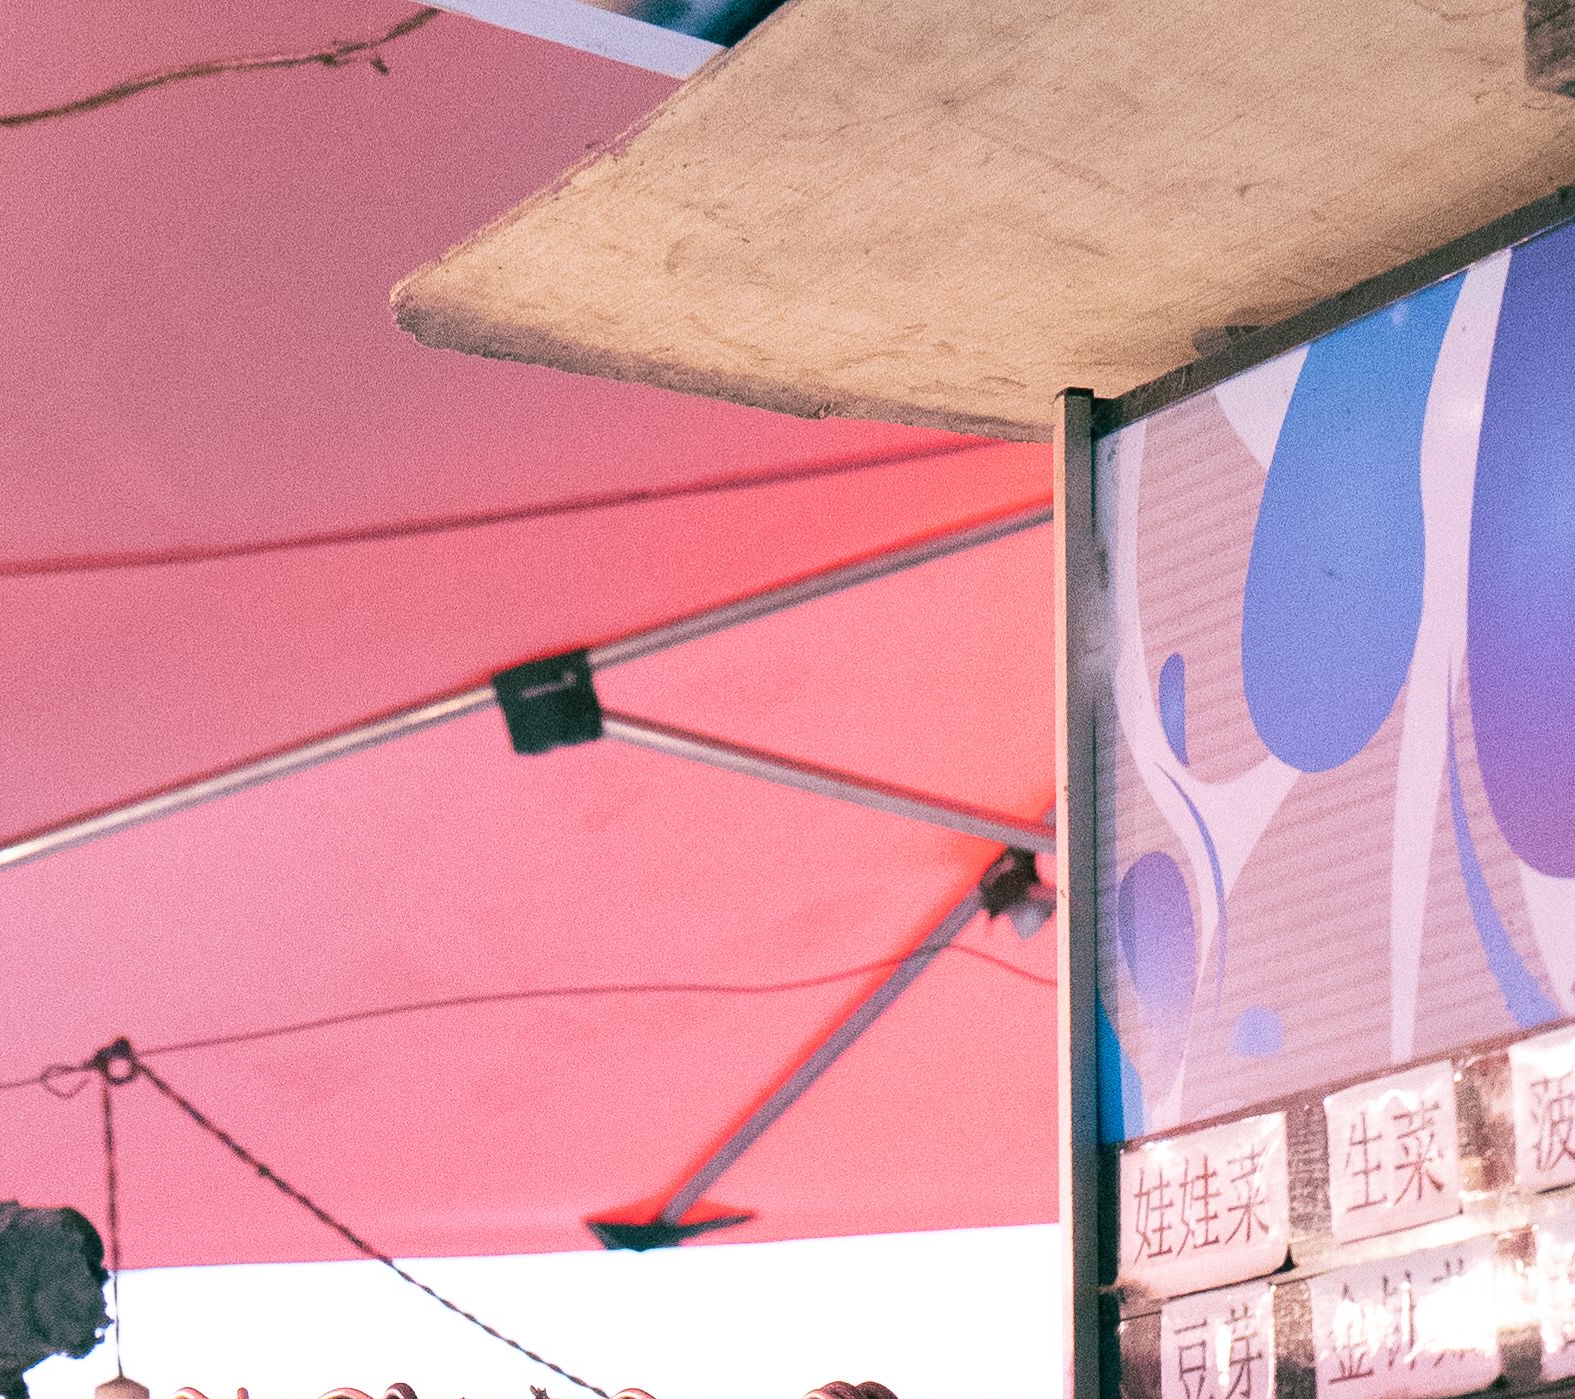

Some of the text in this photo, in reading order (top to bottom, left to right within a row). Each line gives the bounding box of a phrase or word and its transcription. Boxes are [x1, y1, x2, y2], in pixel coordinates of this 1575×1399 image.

[1132, 1144, 1270, 1265] 娃娃菜
[1345, 1098, 1445, 1215] 生菜
